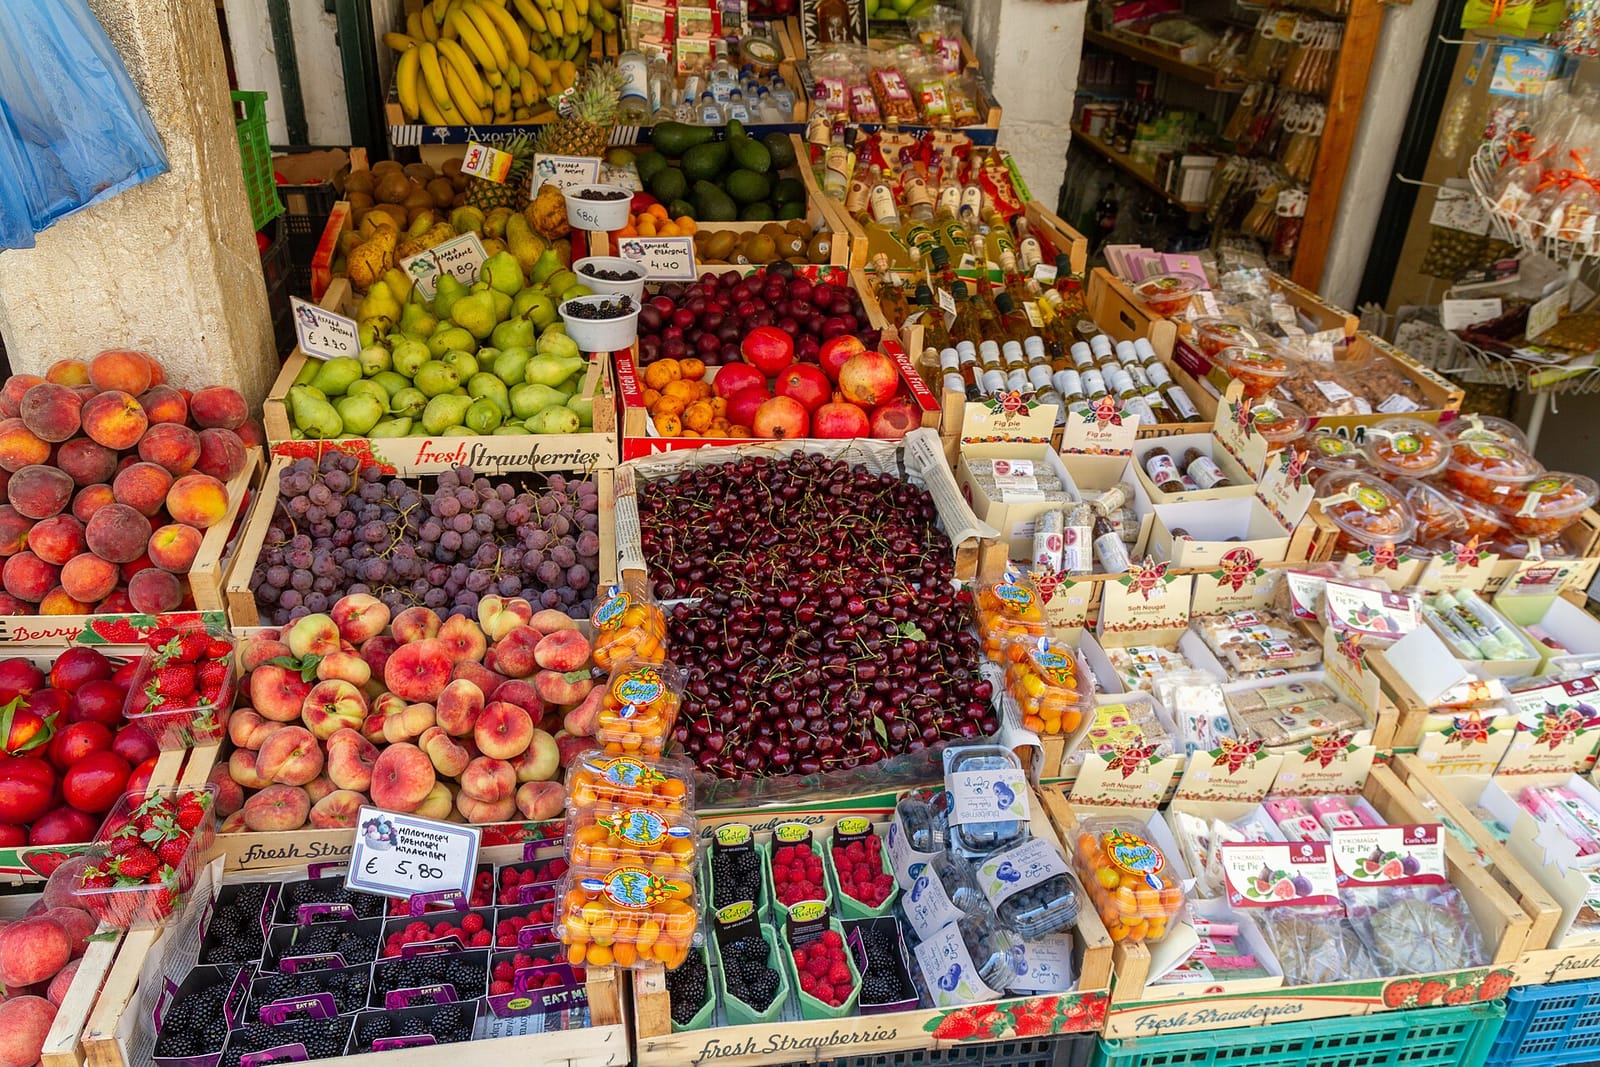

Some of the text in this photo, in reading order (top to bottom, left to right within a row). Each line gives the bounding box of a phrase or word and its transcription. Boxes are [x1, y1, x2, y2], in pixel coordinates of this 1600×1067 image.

[622, 358, 638, 395] Nefeli Fruit
[893, 353, 930, 395] Nefeli Fruit
[993, 420, 1006, 428] Fig
[1086, 430, 1098, 439] Fig
[451, 443, 601, 472] Strawberries
[12, 626, 83, 642] Berry
[1301, 771, 1343, 780] Soft Nougat
[1101, 780, 1143, 790] Soft Nougat
[1224, 778, 1248, 786] Nougat
[1341, 845, 1355, 853] Fig
[365, 857, 443, 880] € 5,80
[1233, 862, 1259, 871] Fig Pie
[542, 991, 569, 1006] EAT
[296, 1002, 307, 1010] EAT
[1187, 1002, 1304, 1026] Strawberries
[761, 1026, 898, 1055] Strawberries
